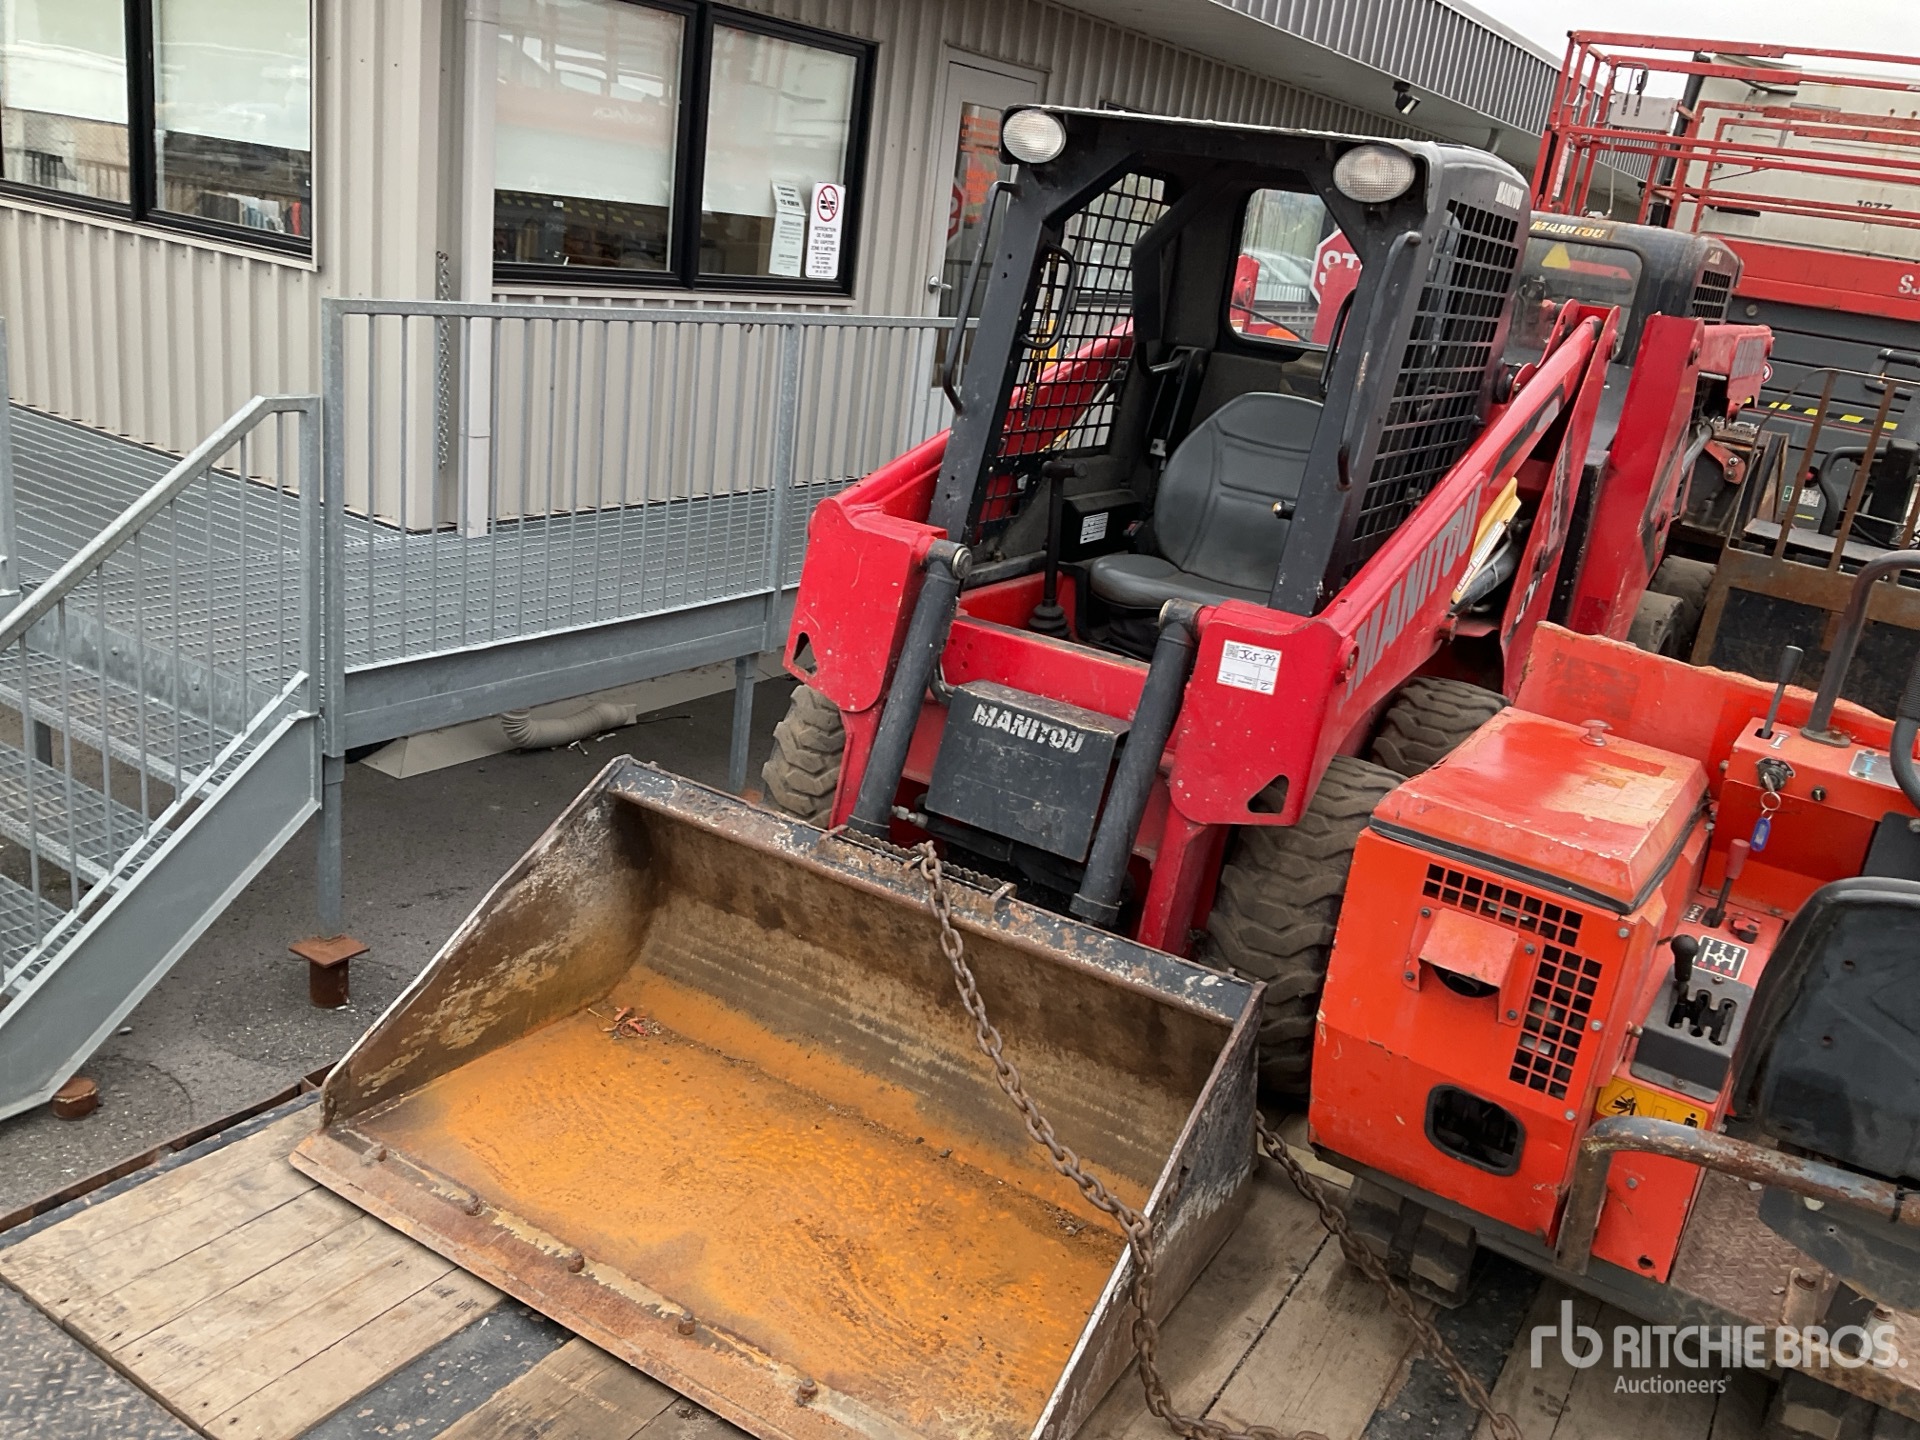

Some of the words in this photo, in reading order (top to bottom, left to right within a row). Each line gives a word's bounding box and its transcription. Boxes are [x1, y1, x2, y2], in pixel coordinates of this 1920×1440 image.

[1530, 219, 1606, 239] MANITOU
[1337, 482, 1483, 714] MANITOU
[972, 703, 1086, 753] MANITOU
